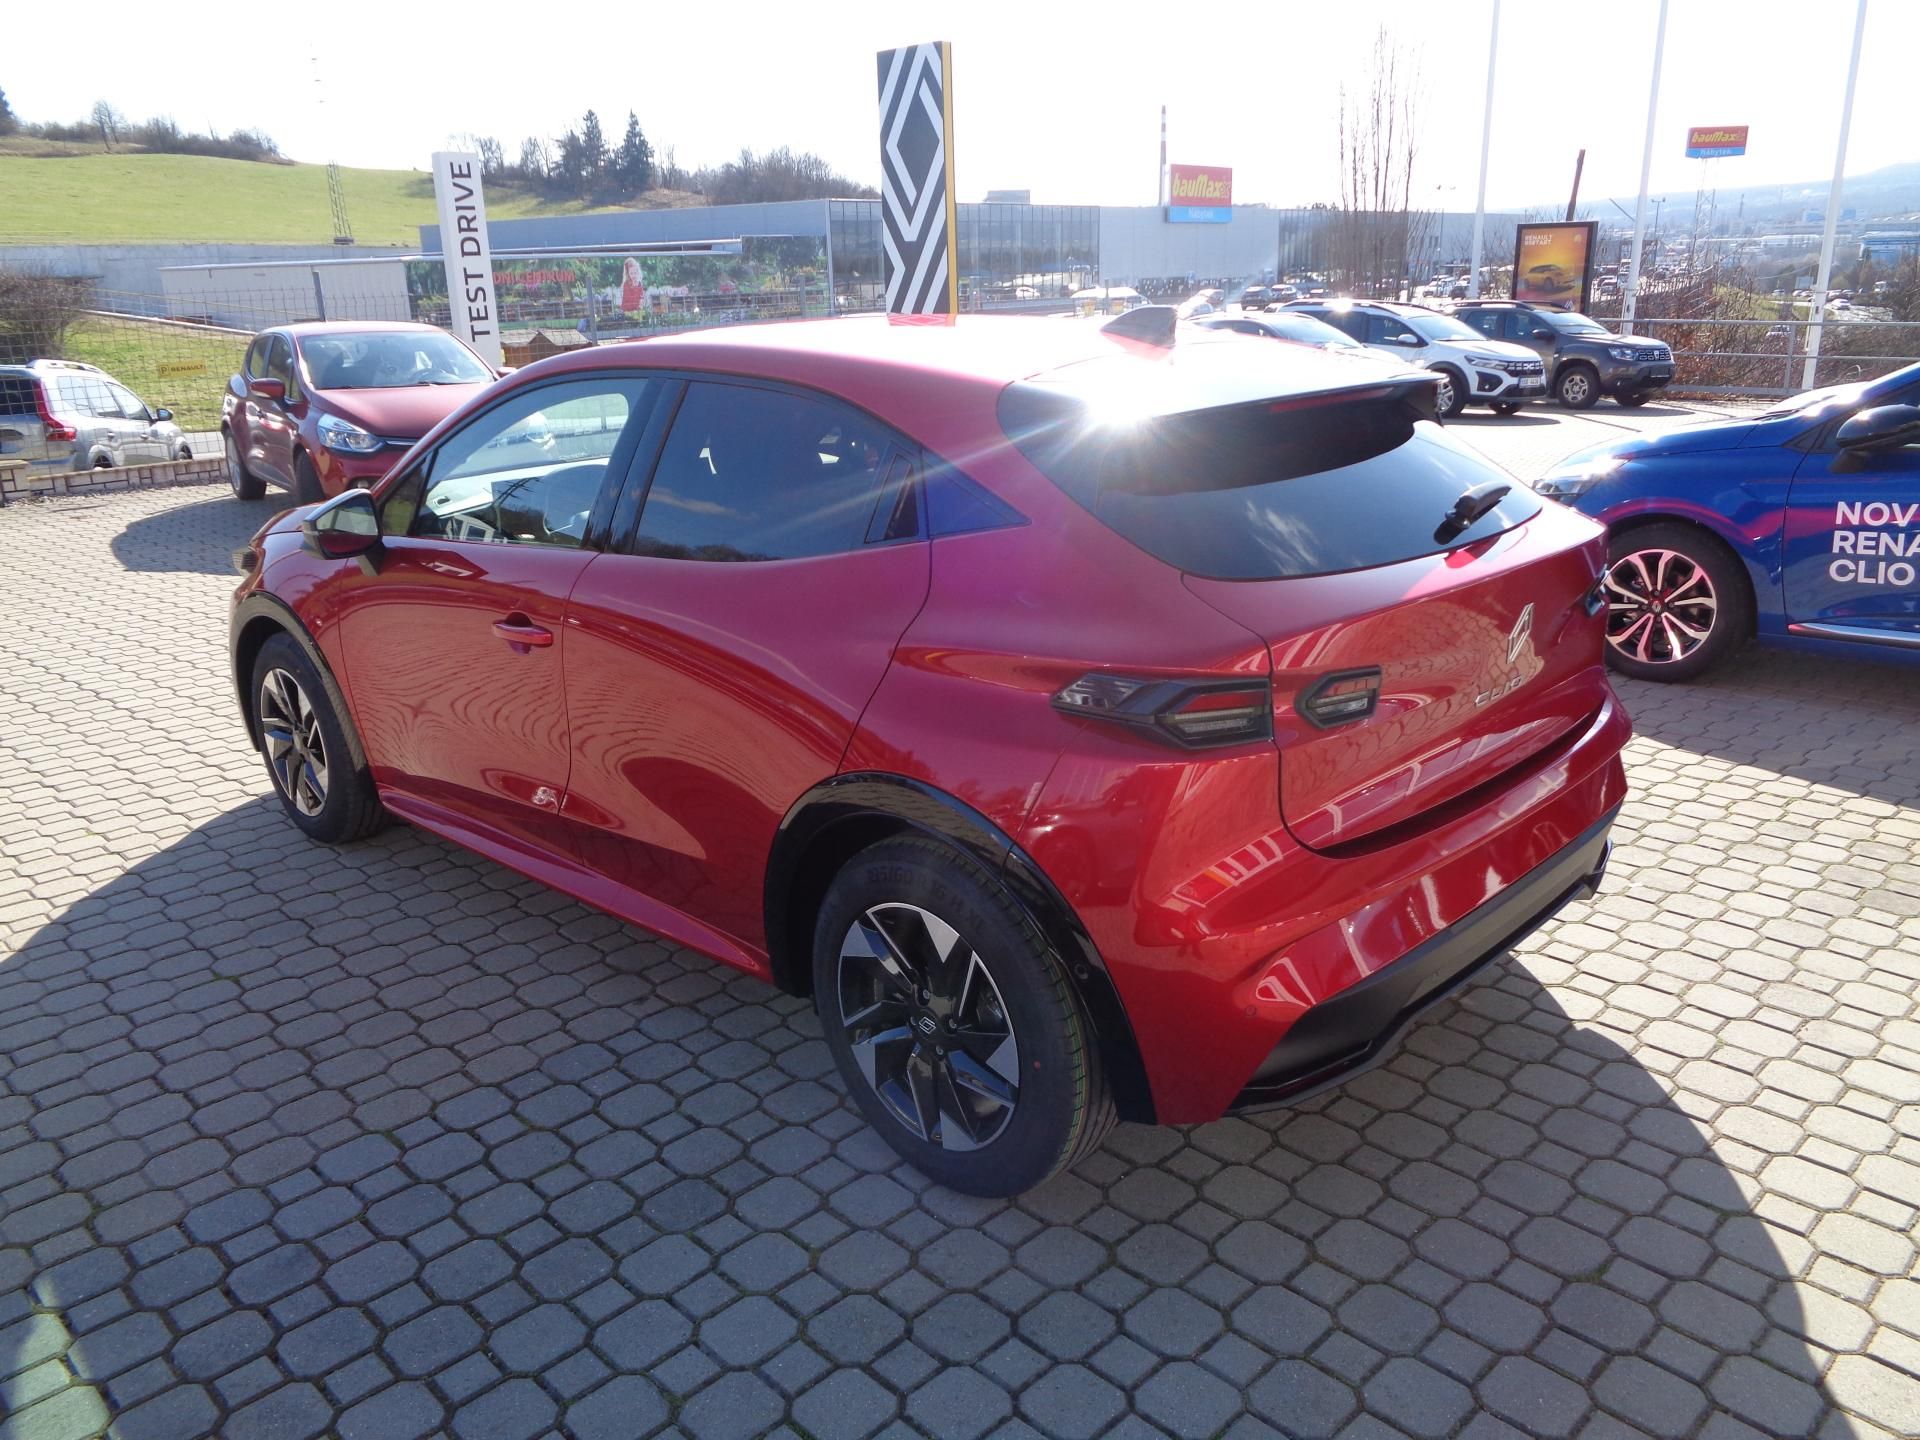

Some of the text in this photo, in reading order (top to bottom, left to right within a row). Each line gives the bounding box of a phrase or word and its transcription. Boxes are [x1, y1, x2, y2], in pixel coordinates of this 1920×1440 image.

[450, 161, 490, 342] TEST DRIVE
[1829, 559, 1915, 586] CLIO
[1474, 675, 1521, 707] CLIO
